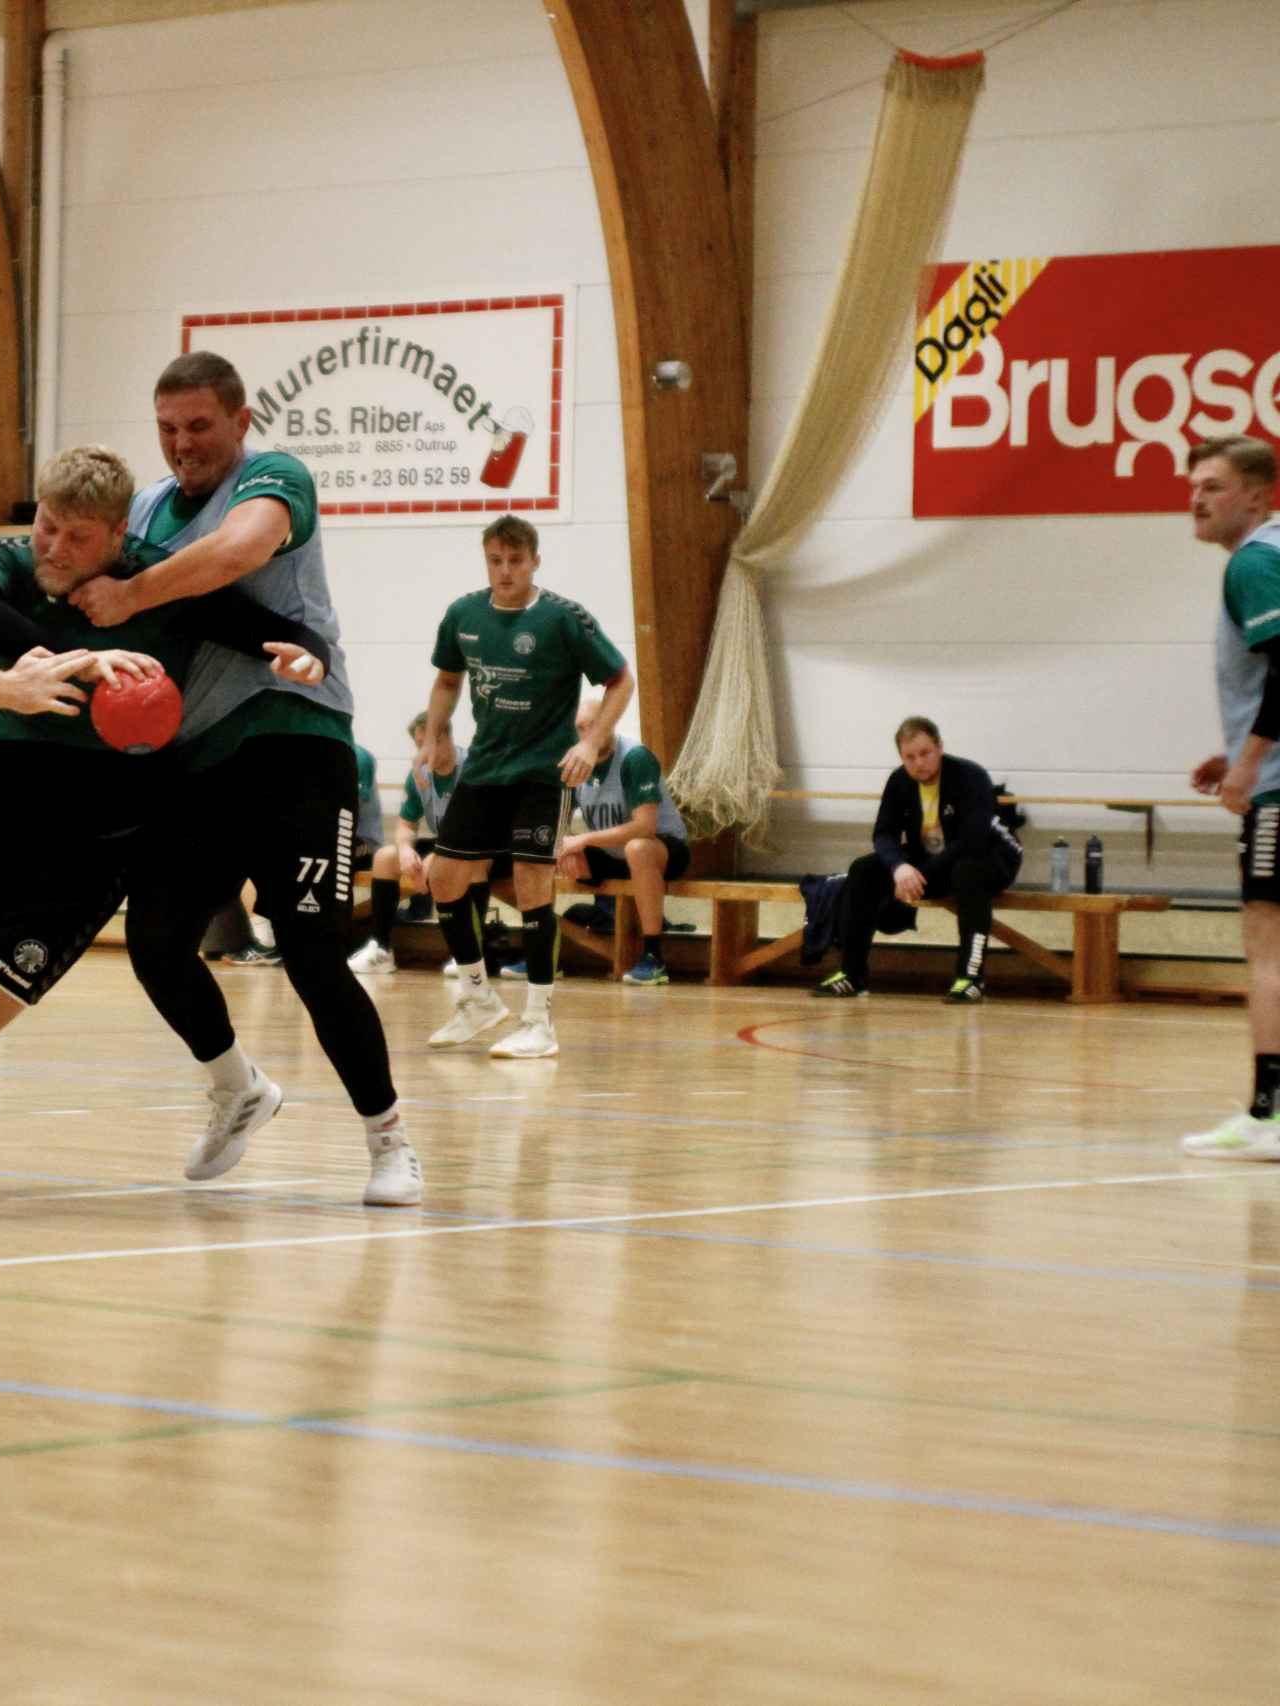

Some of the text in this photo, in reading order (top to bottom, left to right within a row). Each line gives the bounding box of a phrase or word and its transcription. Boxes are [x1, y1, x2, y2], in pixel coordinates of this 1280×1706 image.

[251, 326, 492, 435] Murerfirmaet
[285, 407, 339, 437] B.S.
[350, 405, 423, 435] Riber
[336, 470, 355, 488] 65
[372, 469, 392, 487] 23
[398, 468, 418, 486] 60
[424, 467, 444, 485] 52
[450, 466, 471, 485] 59
[296, 857, 330, 883] 77
